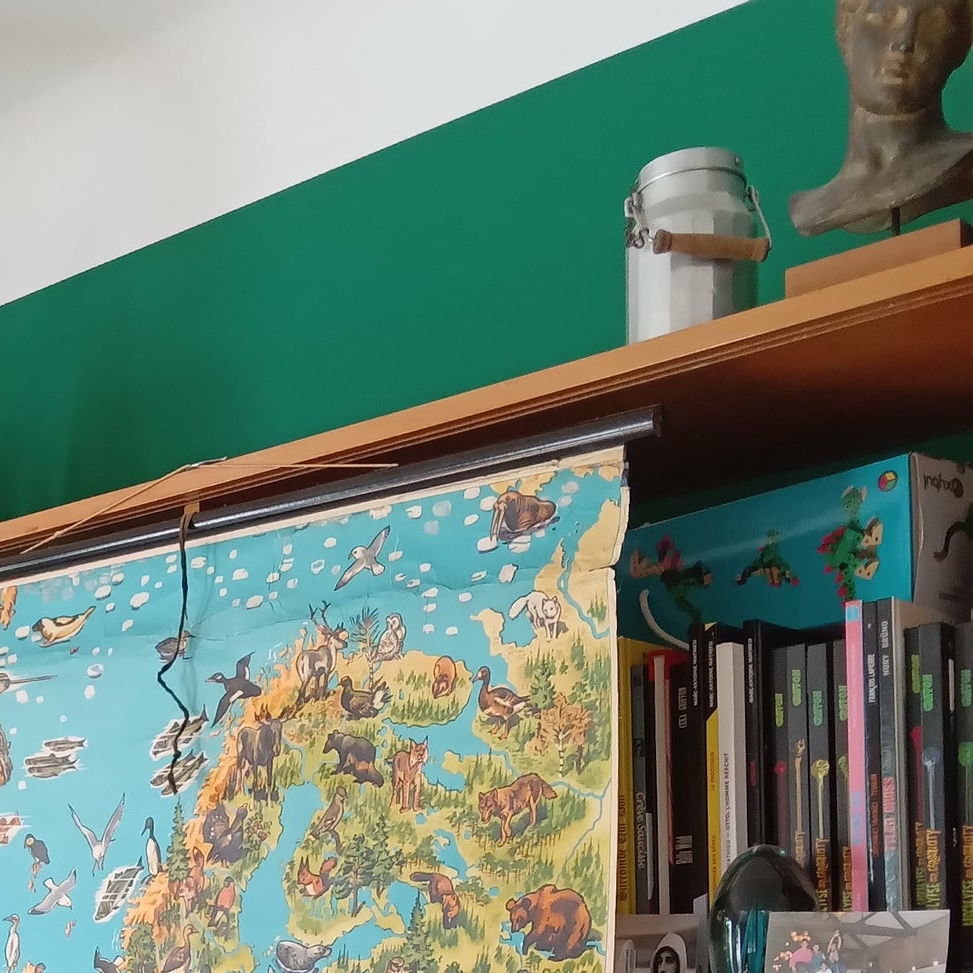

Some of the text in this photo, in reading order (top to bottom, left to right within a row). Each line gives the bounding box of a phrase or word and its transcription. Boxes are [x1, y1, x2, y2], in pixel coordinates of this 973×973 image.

[882, 776, 896, 813] CROSS
[635, 792, 647, 870] Crève Saucisse
